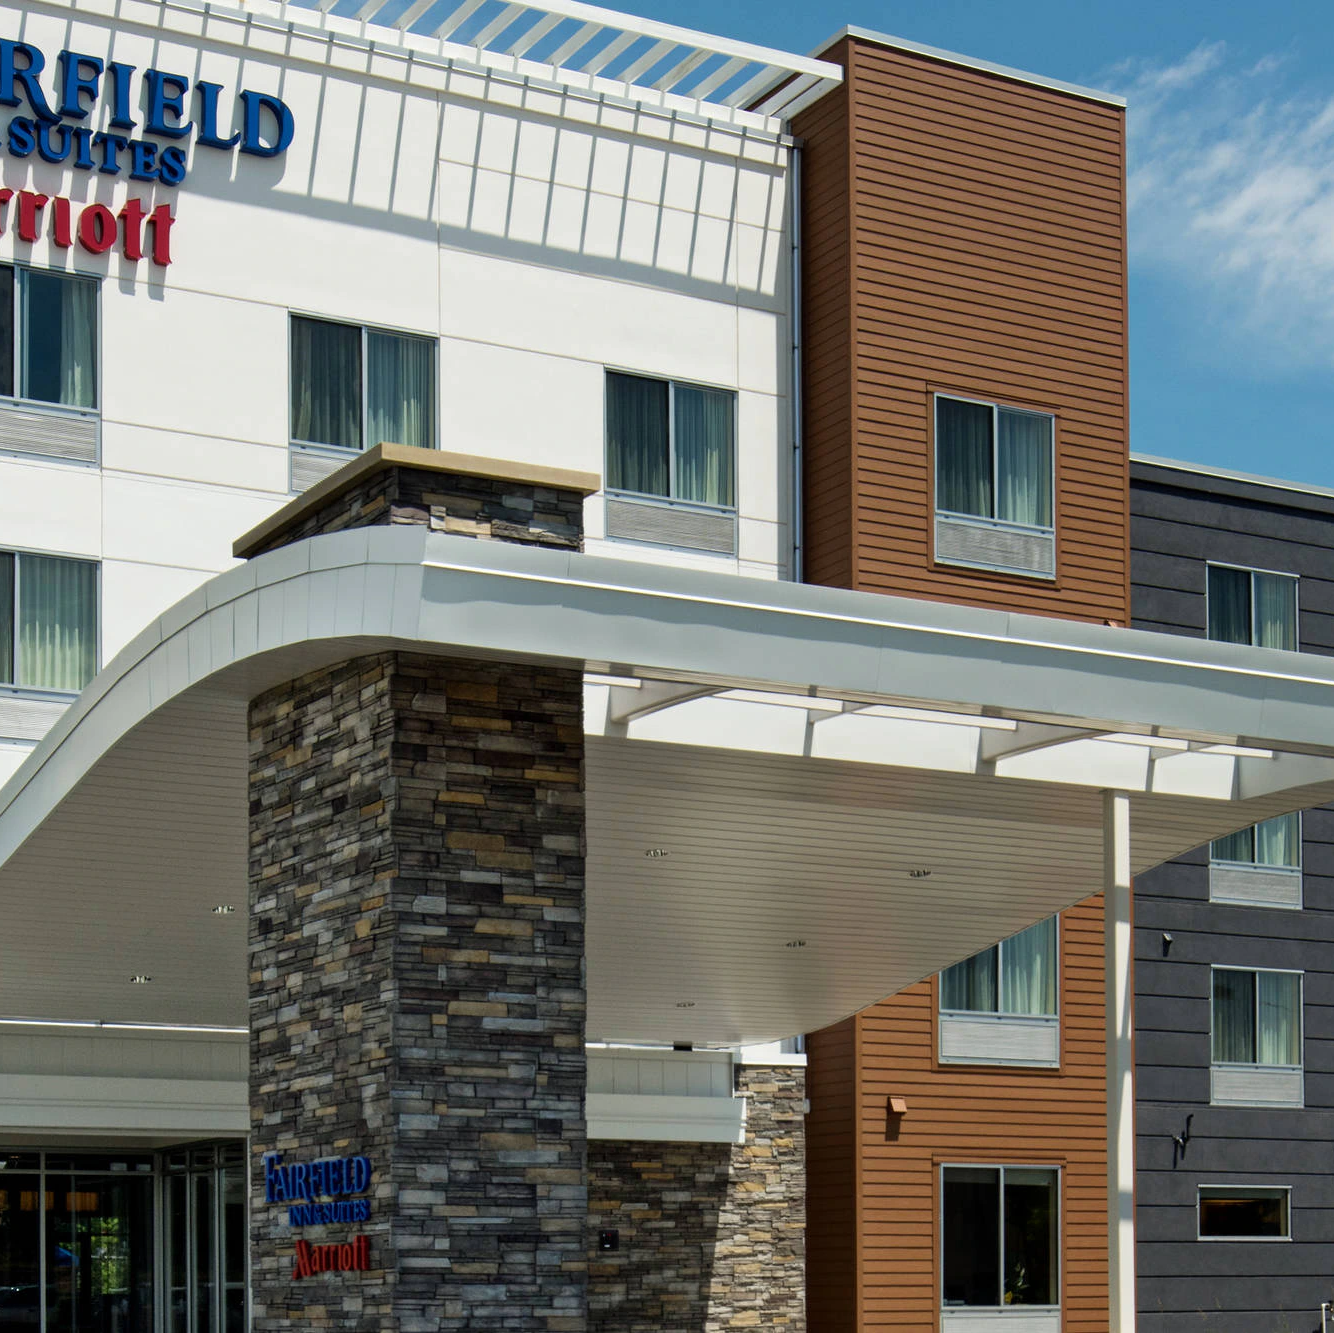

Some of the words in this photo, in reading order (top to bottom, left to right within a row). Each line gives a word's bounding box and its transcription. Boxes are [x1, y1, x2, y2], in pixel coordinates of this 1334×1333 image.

[8, 116, 186, 187] SUITES
[264, 1154, 371, 1202] FAIRFIELD
[292, 1235, 370, 1280] Marriott
